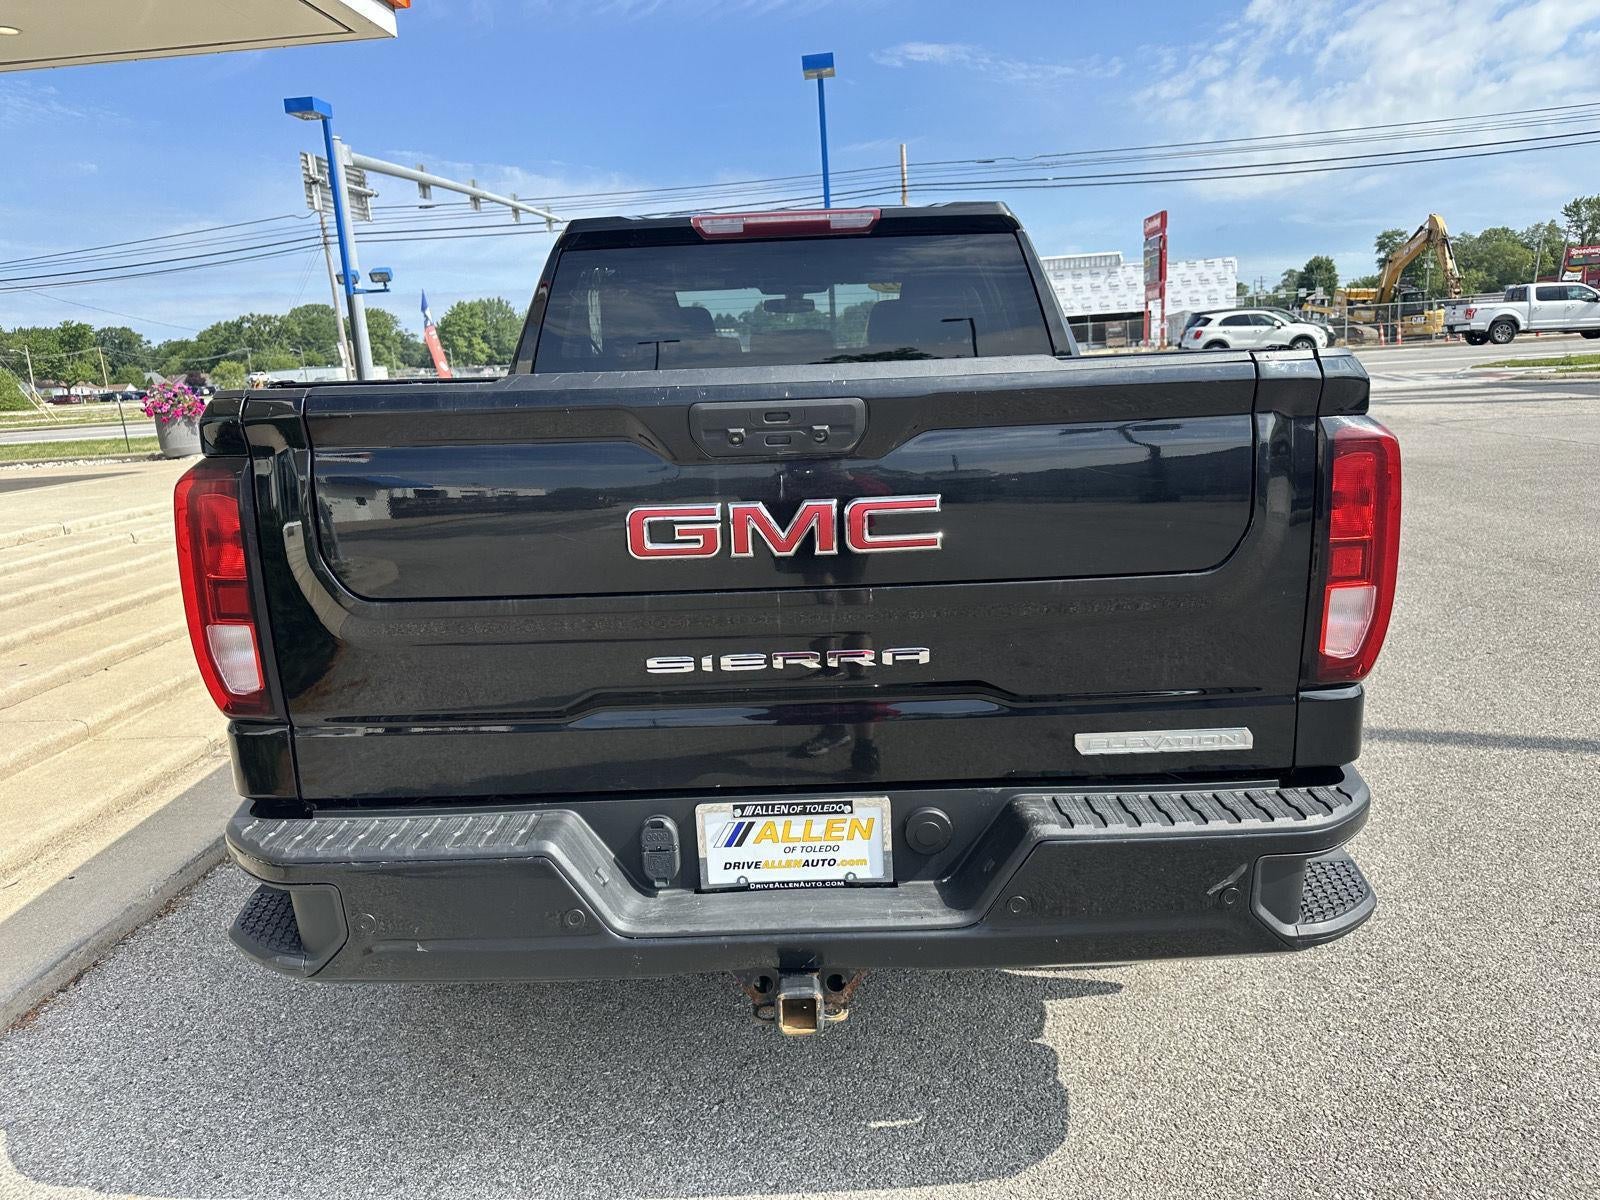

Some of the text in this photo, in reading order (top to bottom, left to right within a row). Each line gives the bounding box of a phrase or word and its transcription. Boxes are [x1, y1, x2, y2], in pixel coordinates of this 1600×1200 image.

[626, 494, 943, 560] GMC
[646, 647, 930, 674] SIERRA
[1089, 733, 1239, 750] ELEVATION
[754, 804, 844, 815] ALLEN OF TOLEDO
[752, 818, 875, 844] ALLEN
[783, 844, 840, 854] OF TOLEDO
